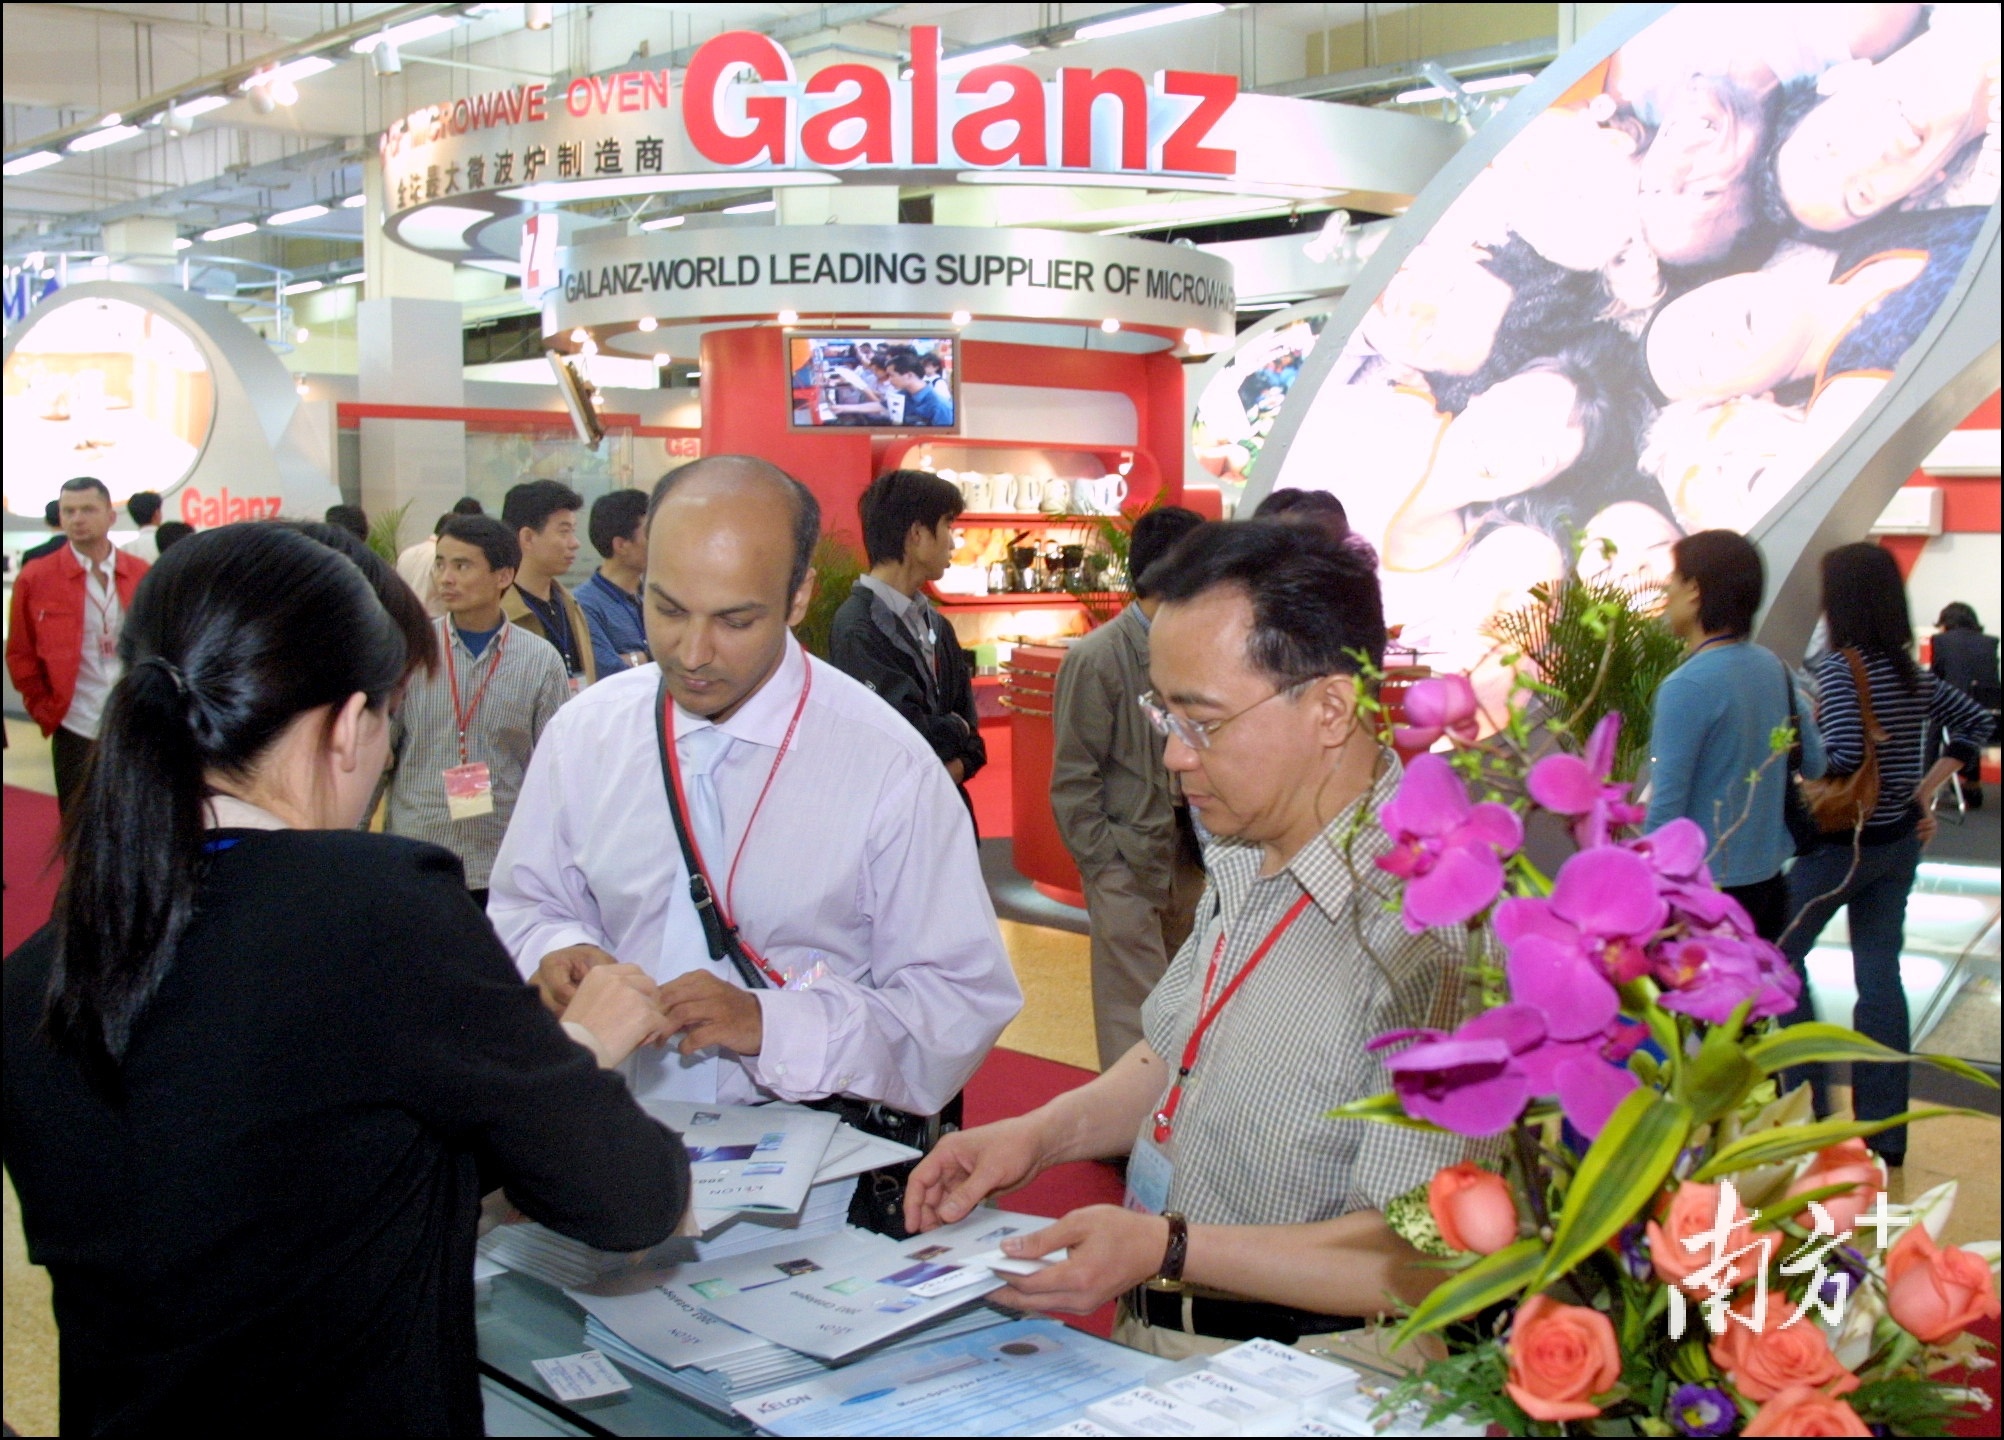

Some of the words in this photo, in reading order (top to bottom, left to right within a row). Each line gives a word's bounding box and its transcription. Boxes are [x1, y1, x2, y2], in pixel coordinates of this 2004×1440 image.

[407, 84, 547, 150] CROWAVE
[565, 69, 670, 118] OVEN
[682, 25, 1239, 175] Galanz
[564, 254, 761, 303] GALANZ-WORLD
[769, 252, 927, 285] LEADING
[935, 254, 1095, 293] SUPPLIER
[1104, 263, 1140, 295] OF
[181, 486, 283, 528] Galanz
[756, 1393, 813, 1415] KELON
